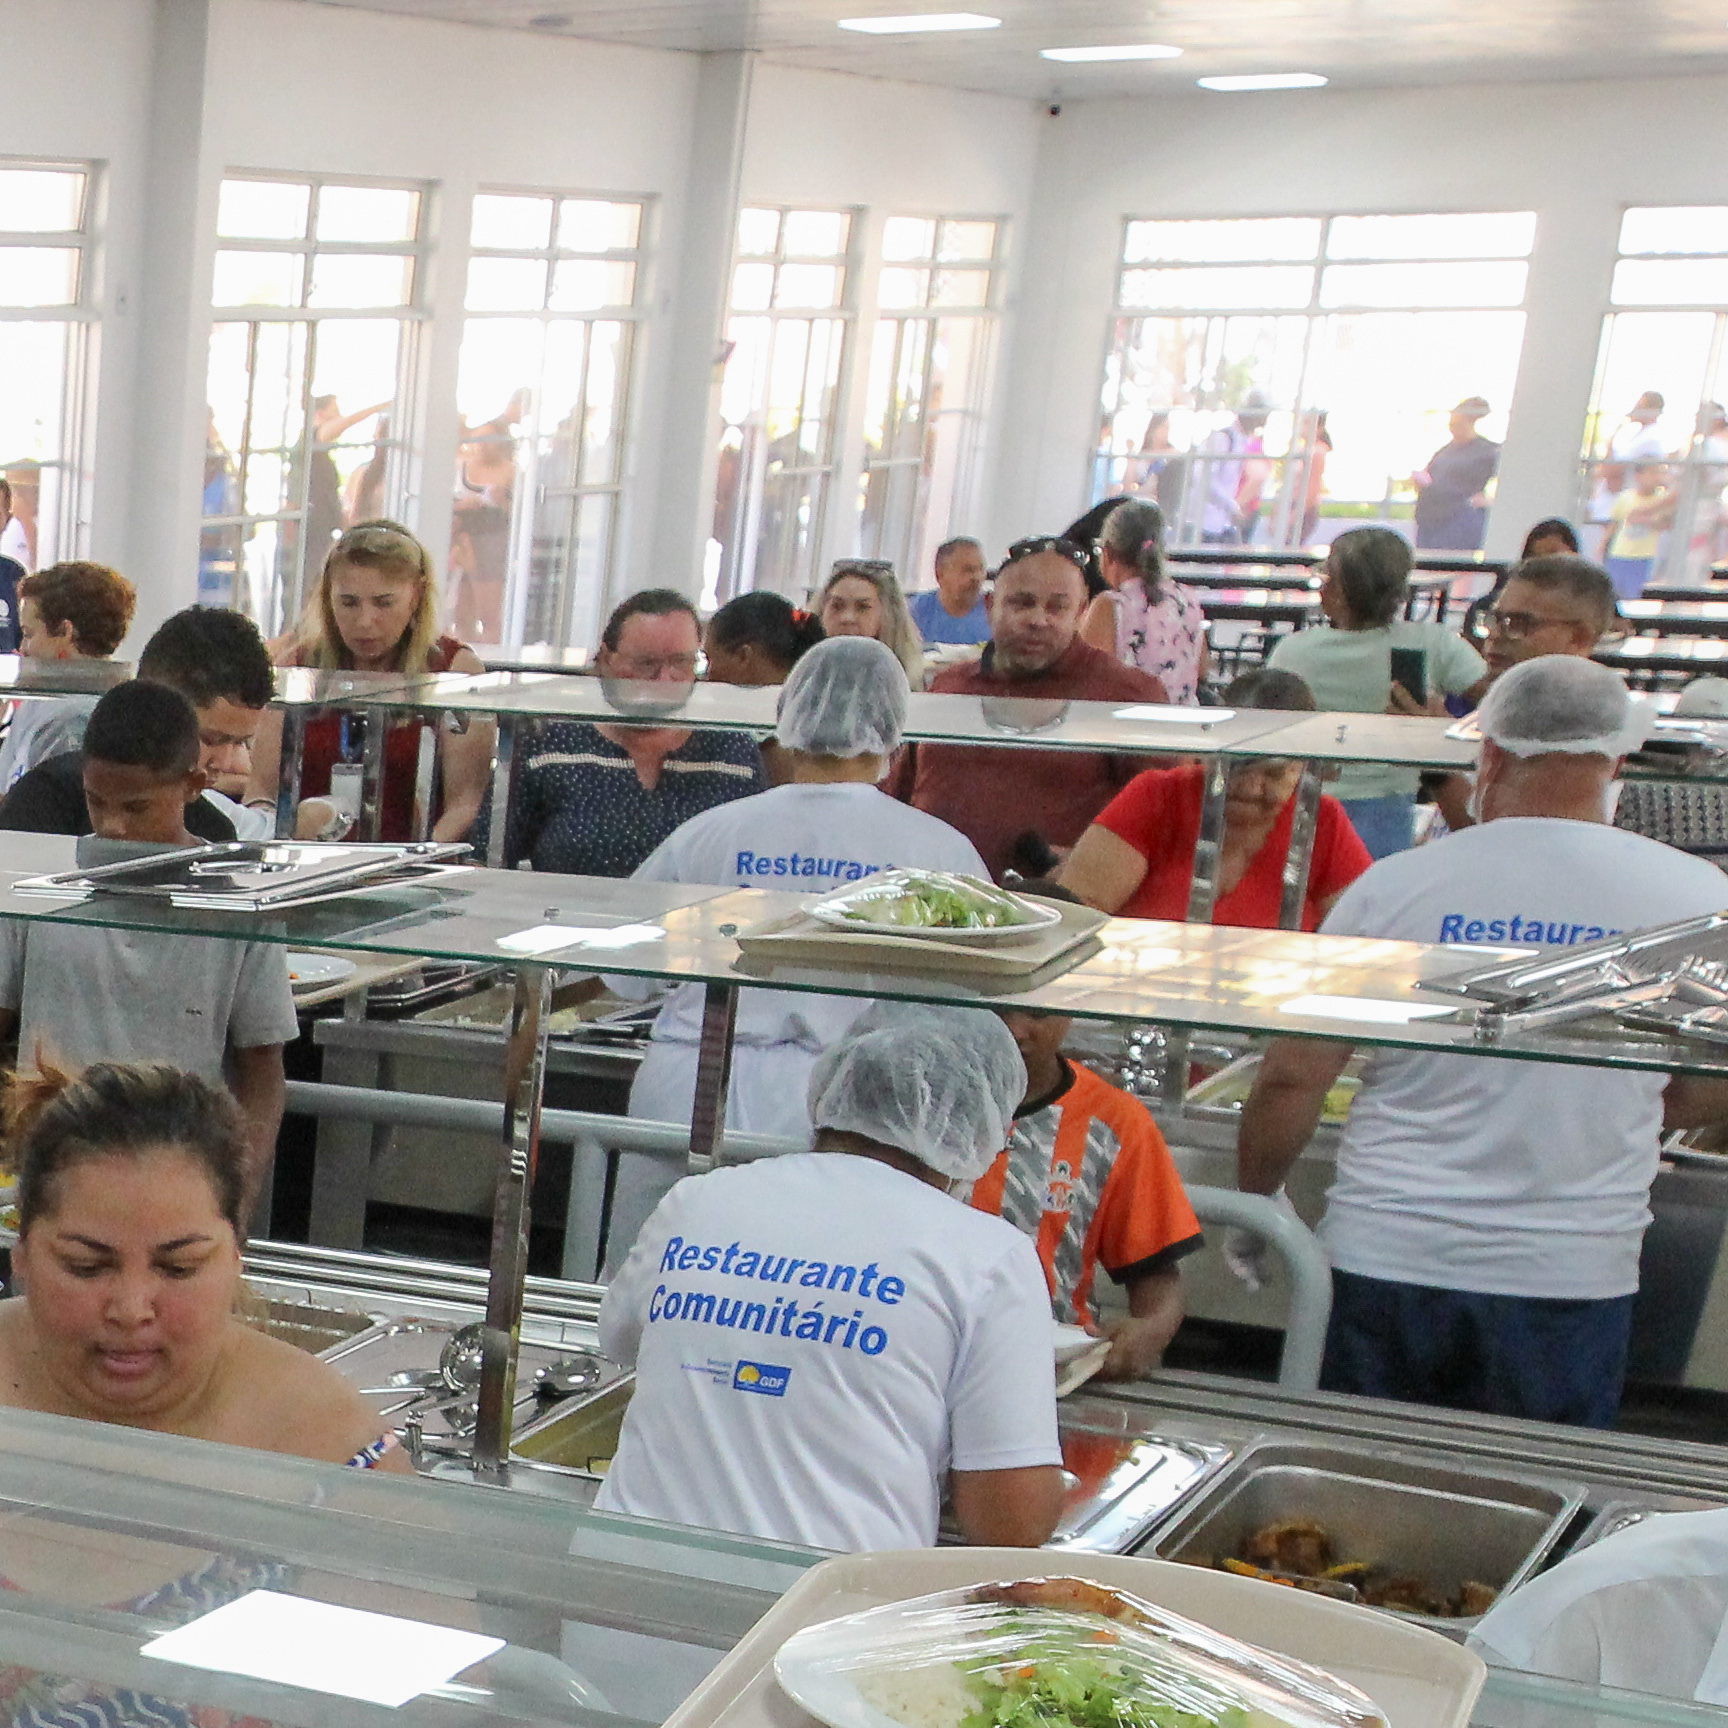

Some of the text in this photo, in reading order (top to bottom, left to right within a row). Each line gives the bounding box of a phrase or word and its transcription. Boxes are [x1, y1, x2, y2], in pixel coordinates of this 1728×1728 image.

[737, 850, 892, 881] Restauran
[1440, 913, 1623, 945] Restaura
[659, 1236, 906, 1305] Restaurante
[649, 1284, 889, 1356] Comunitário
[760, 1376, 785, 1389] GDF
